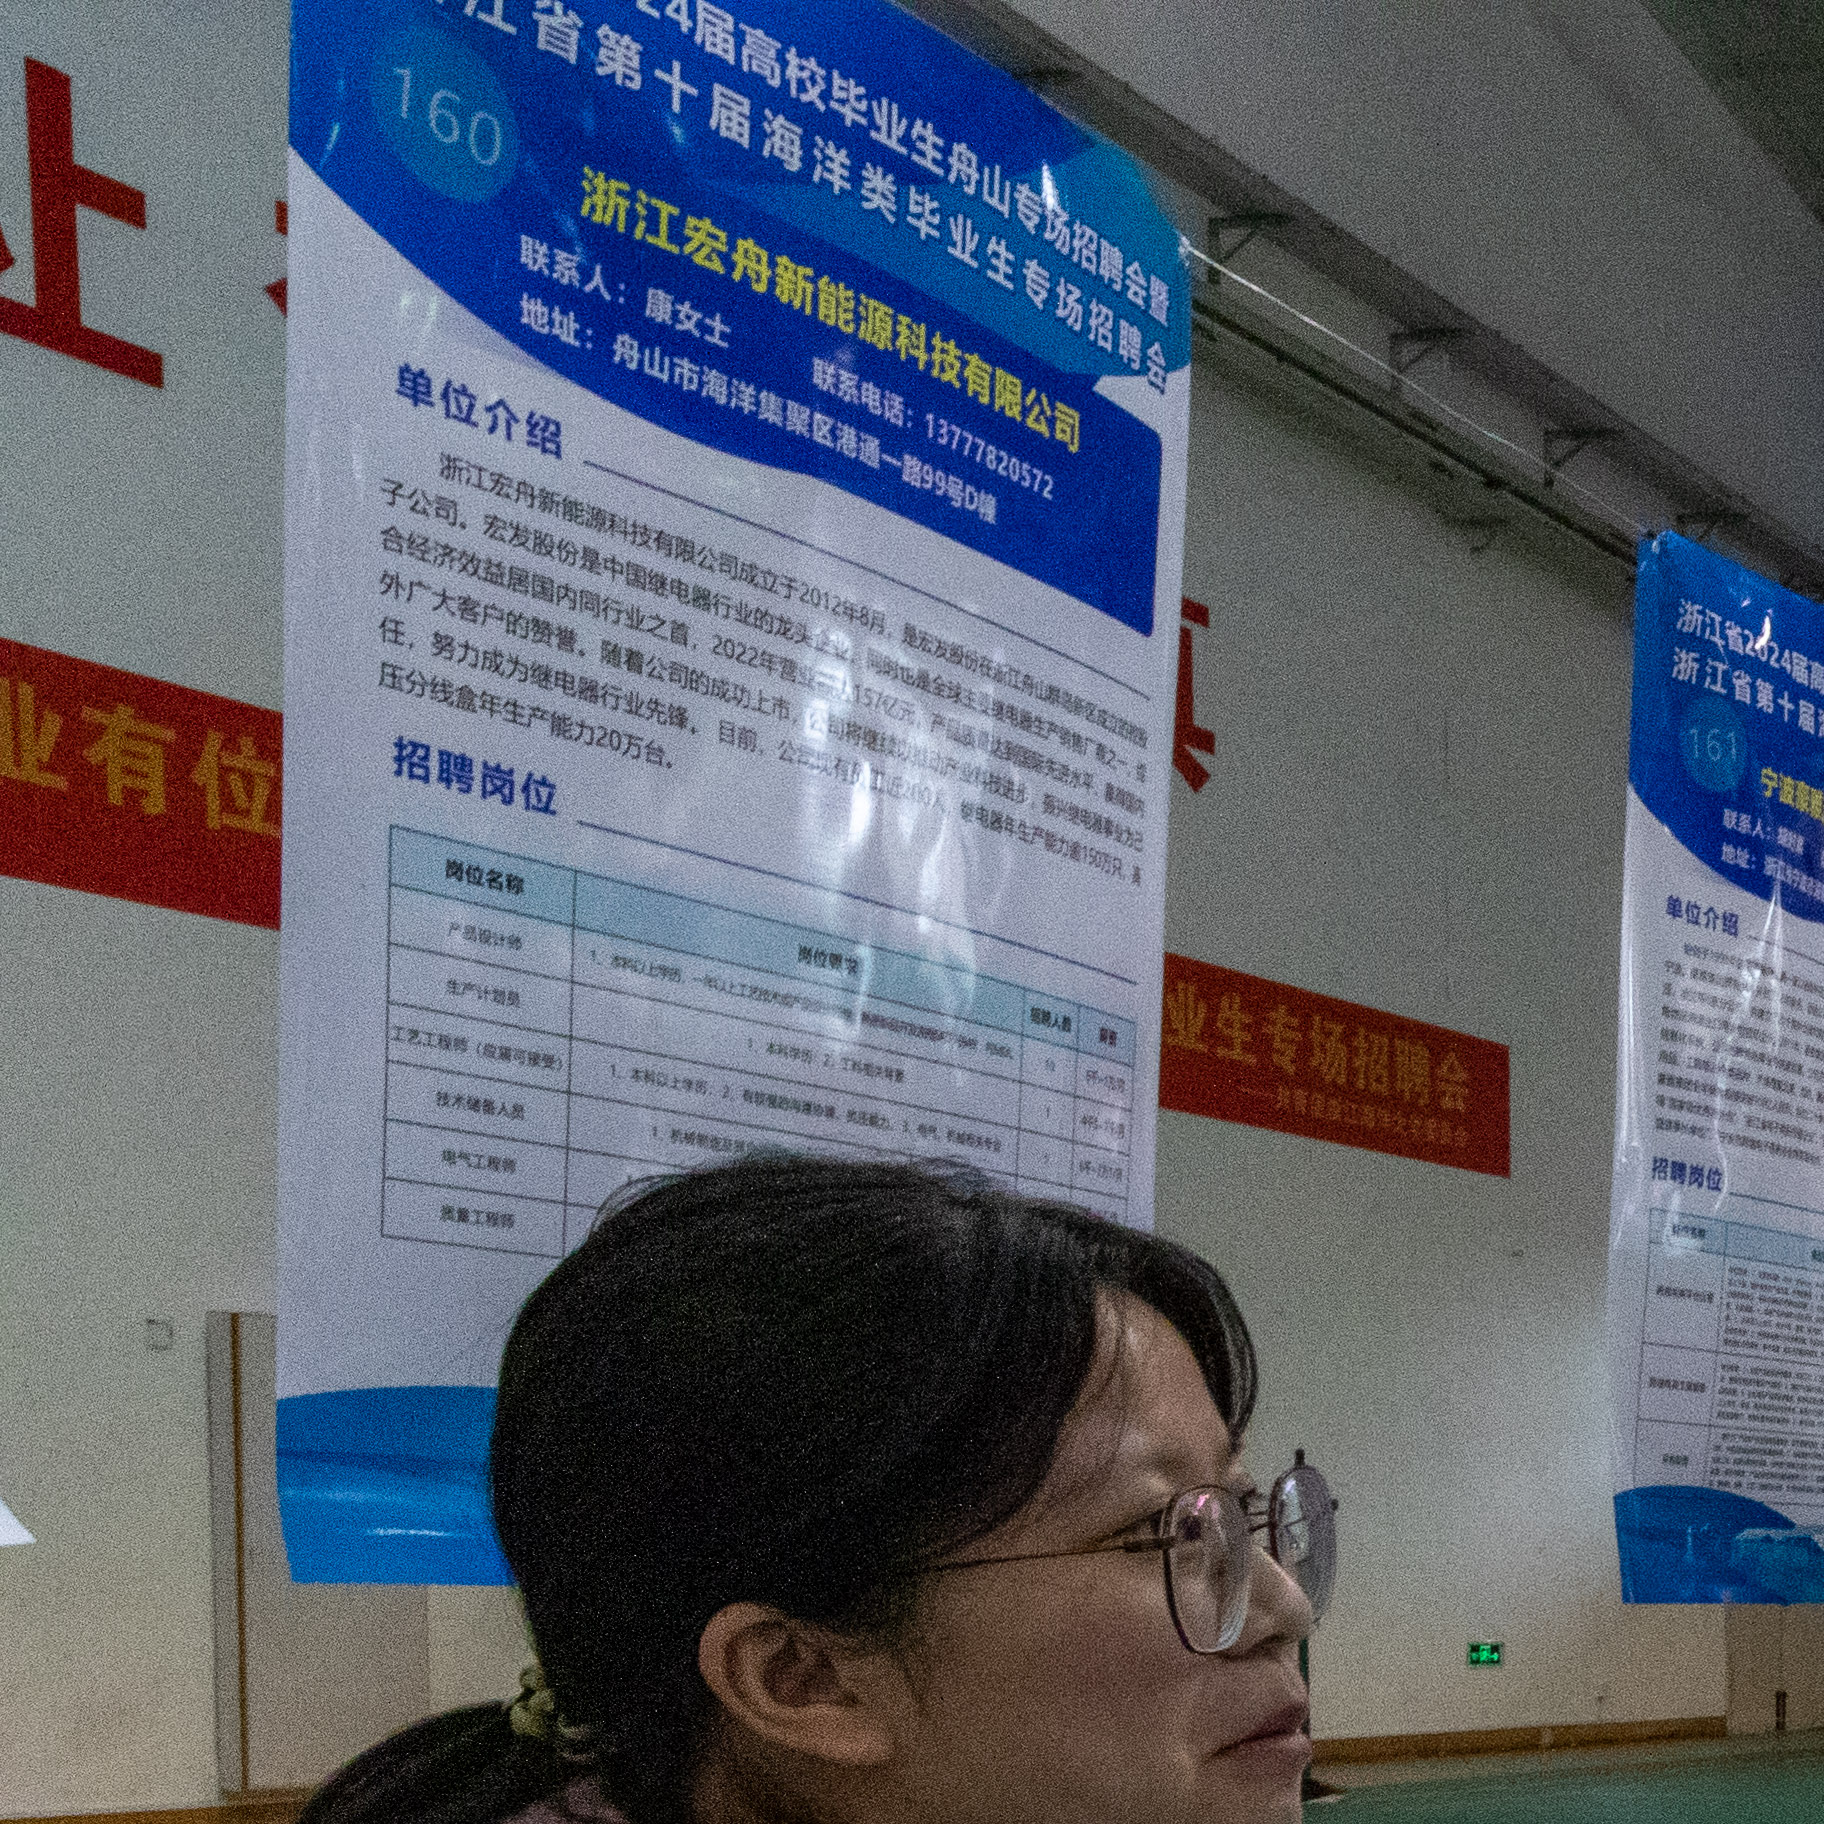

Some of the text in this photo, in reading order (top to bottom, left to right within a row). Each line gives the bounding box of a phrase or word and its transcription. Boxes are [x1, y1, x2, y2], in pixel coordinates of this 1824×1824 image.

[393, 68, 501, 166] 160
[636, 0, 1170, 327] 4届高校毕业生舟山专场招聘会暨
[580, 165, 1081, 455] 浙江宏舟新能源科技有限公司
[396, 362, 564, 461] 单位介绍
[391, 735, 558, 817] 招聘岗位
[1688, 727, 1740, 762] 161
[444, 858, 525, 897] 岗位名称
[1665, 894, 1741, 939] 单位介绍
[1650, 1155, 1724, 1193] 招聘岗位
